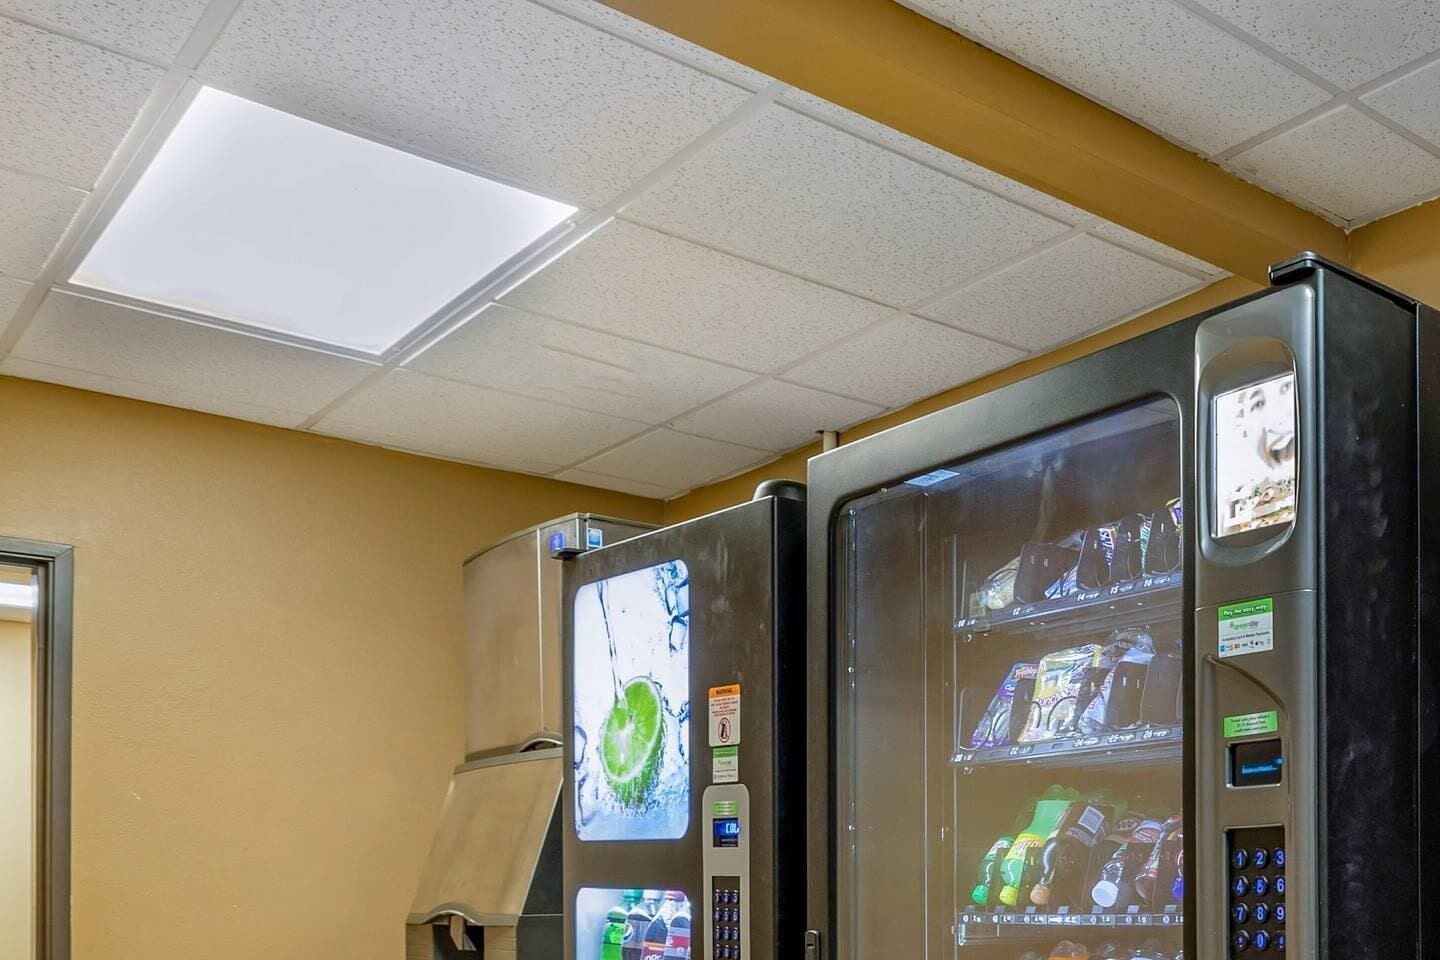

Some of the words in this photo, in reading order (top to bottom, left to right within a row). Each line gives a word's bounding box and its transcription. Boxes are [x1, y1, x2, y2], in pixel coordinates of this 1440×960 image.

[1237, 854, 1243, 865] 1
[1256, 853, 1264, 865] 2
[1276, 852, 1284, 864] 3
[1236, 881, 1243, 893] 4
[1256, 880, 1264, 892] 5
[1277, 879, 1284, 892] 6
[1237, 908, 1243, 920] 7
[1257, 907, 1264, 920] 8
[1277, 907, 1284, 920] 9
[1257, 936, 1264, 948] 0
